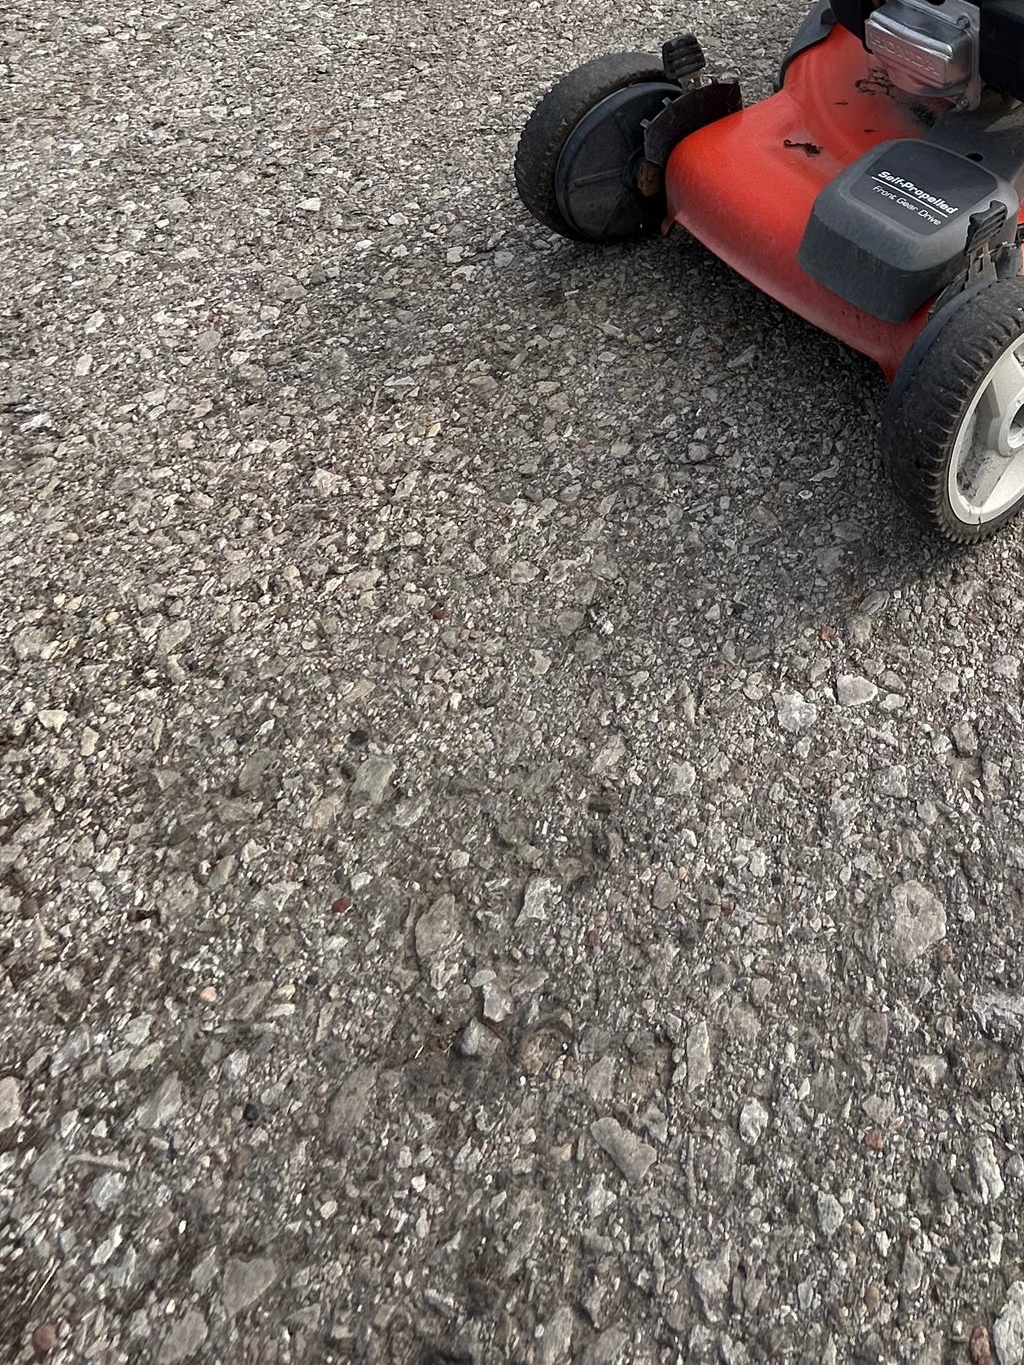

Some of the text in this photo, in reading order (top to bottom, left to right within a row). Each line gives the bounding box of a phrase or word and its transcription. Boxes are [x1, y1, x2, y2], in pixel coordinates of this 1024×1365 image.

[872, 184, 941, 226] Front Gear Drive
[877, 170, 959, 215] Self-Propelled
